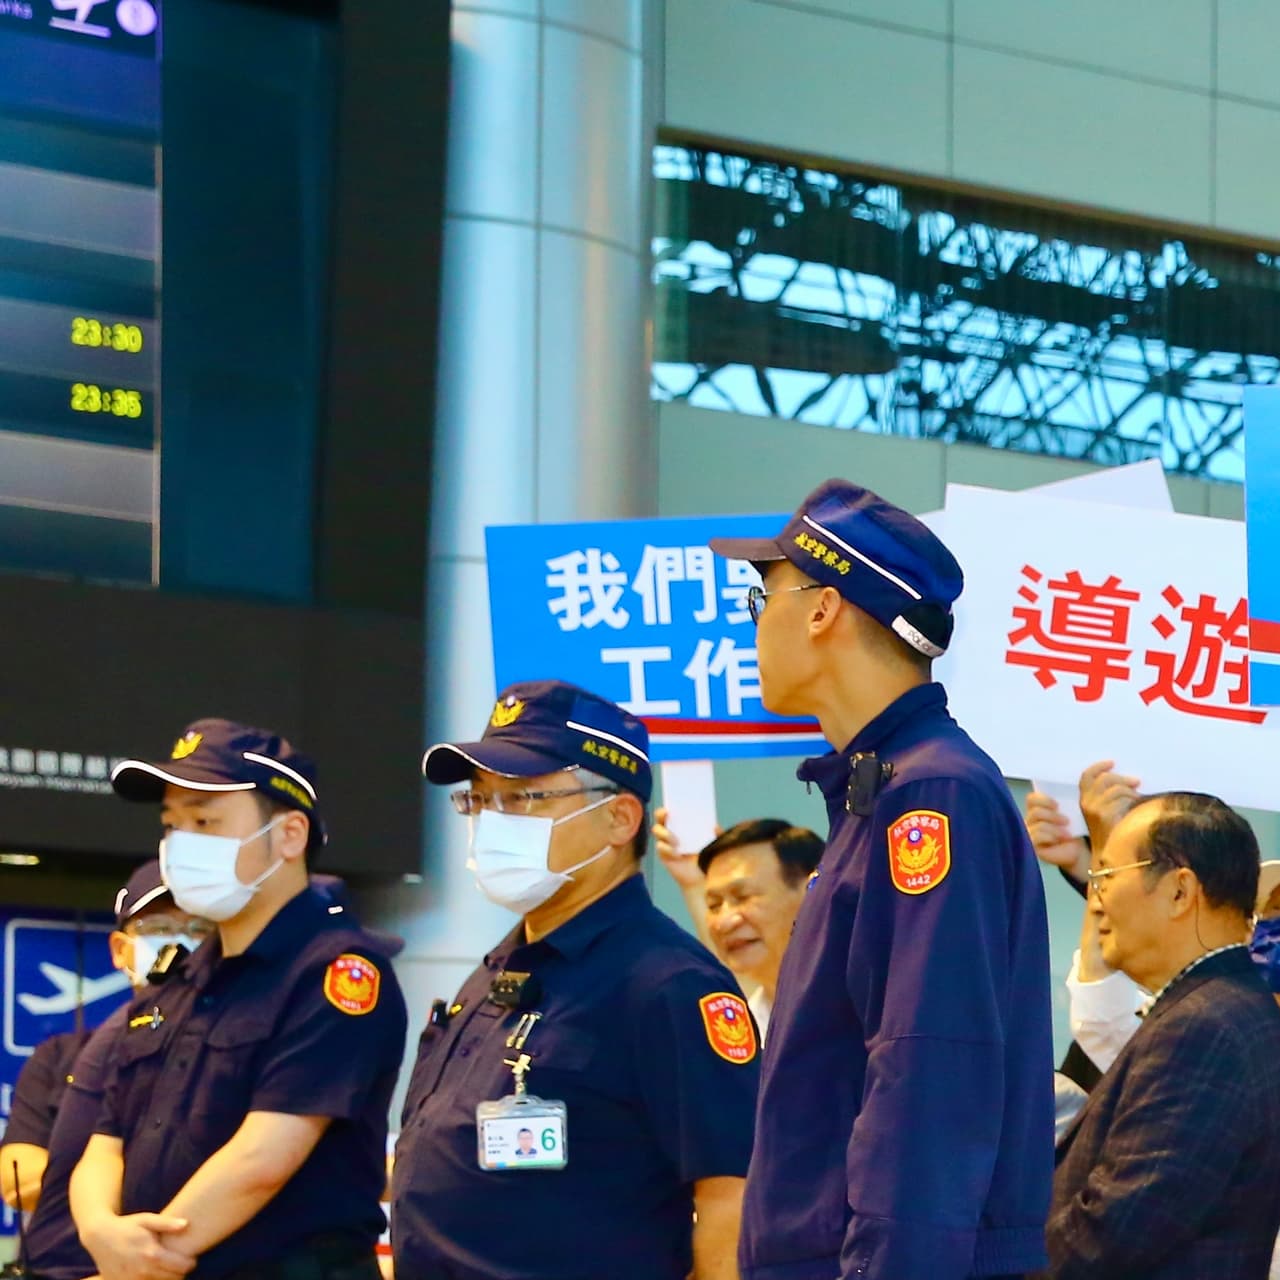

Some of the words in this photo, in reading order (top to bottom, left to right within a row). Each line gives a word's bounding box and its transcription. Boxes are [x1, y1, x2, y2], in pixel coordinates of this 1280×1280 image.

[71, 316, 142, 353] 23:30
[71, 383, 142, 418] 23:35
[1005, 564, 1267, 724] 導遊
[601, 637, 762, 717] 工作
[906, 874, 931, 887] 1442
[541, 1128, 557, 1151] 6
